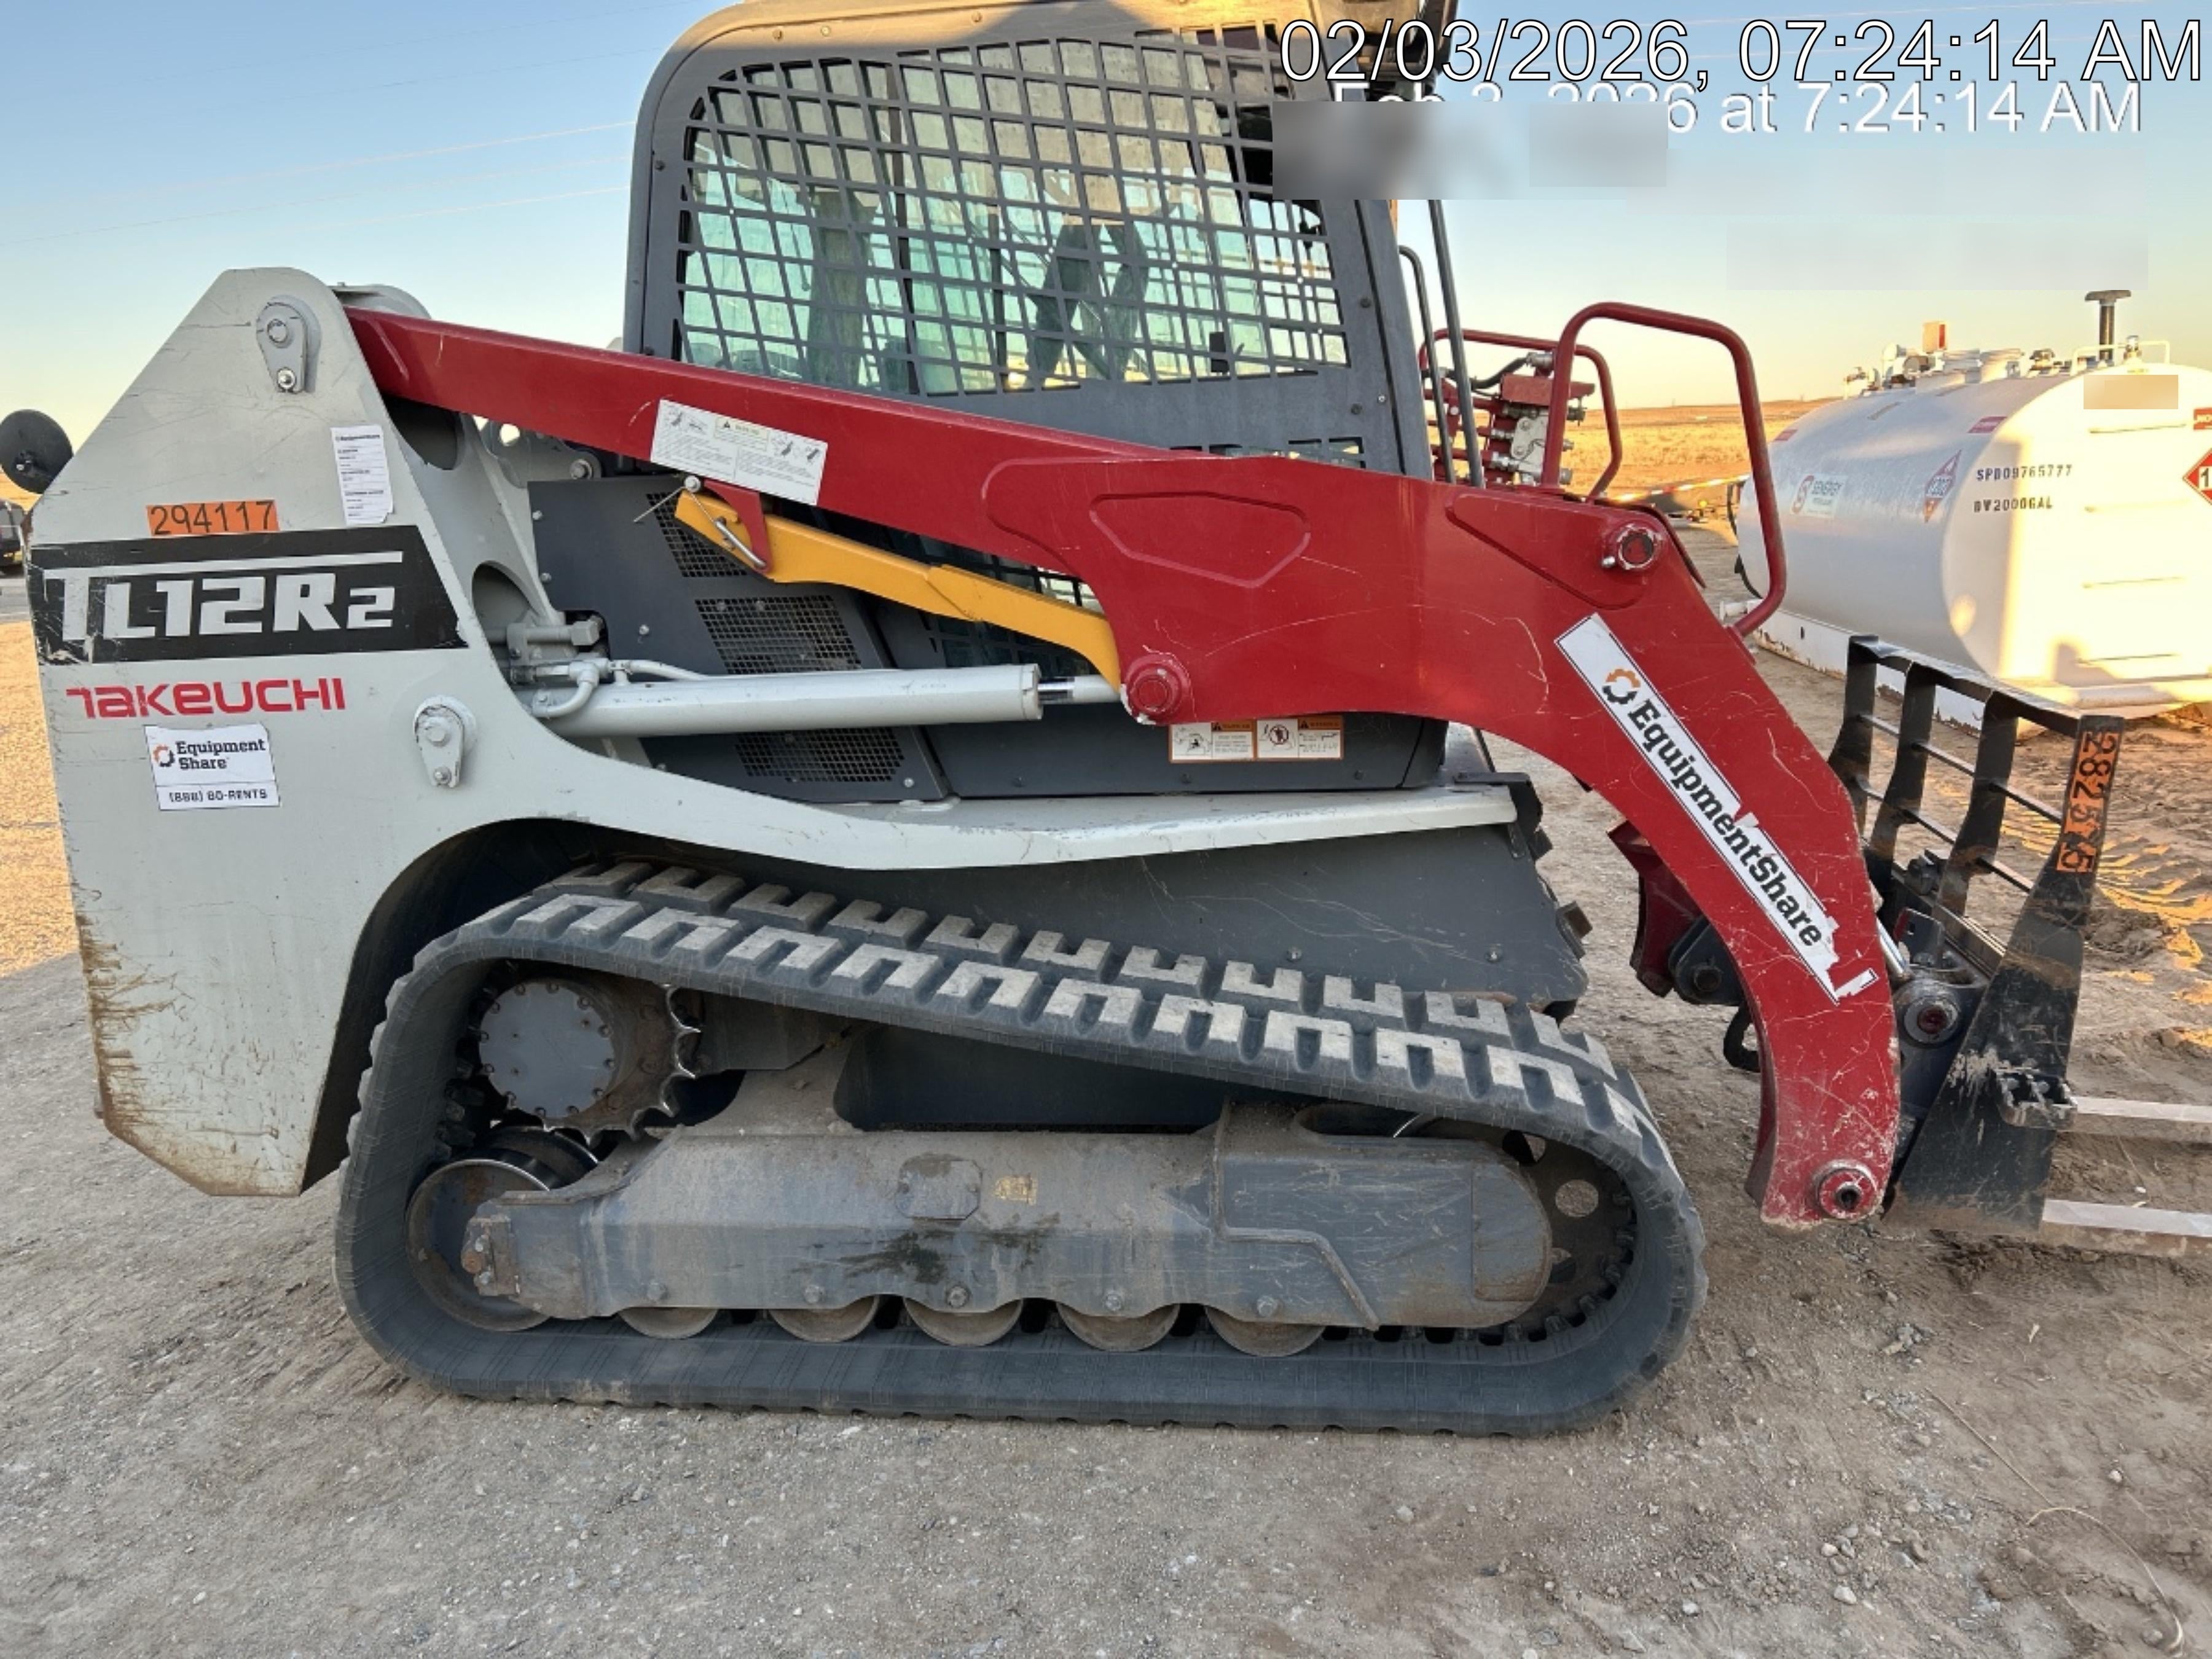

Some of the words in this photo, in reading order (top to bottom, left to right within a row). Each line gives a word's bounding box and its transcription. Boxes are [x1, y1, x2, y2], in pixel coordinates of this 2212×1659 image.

[151, 500, 276, 535] 294117
[176, 739, 266, 756] Equipment
[179, 757, 228, 770] Share
[1627, 700, 1822, 947] EquipmentShare
